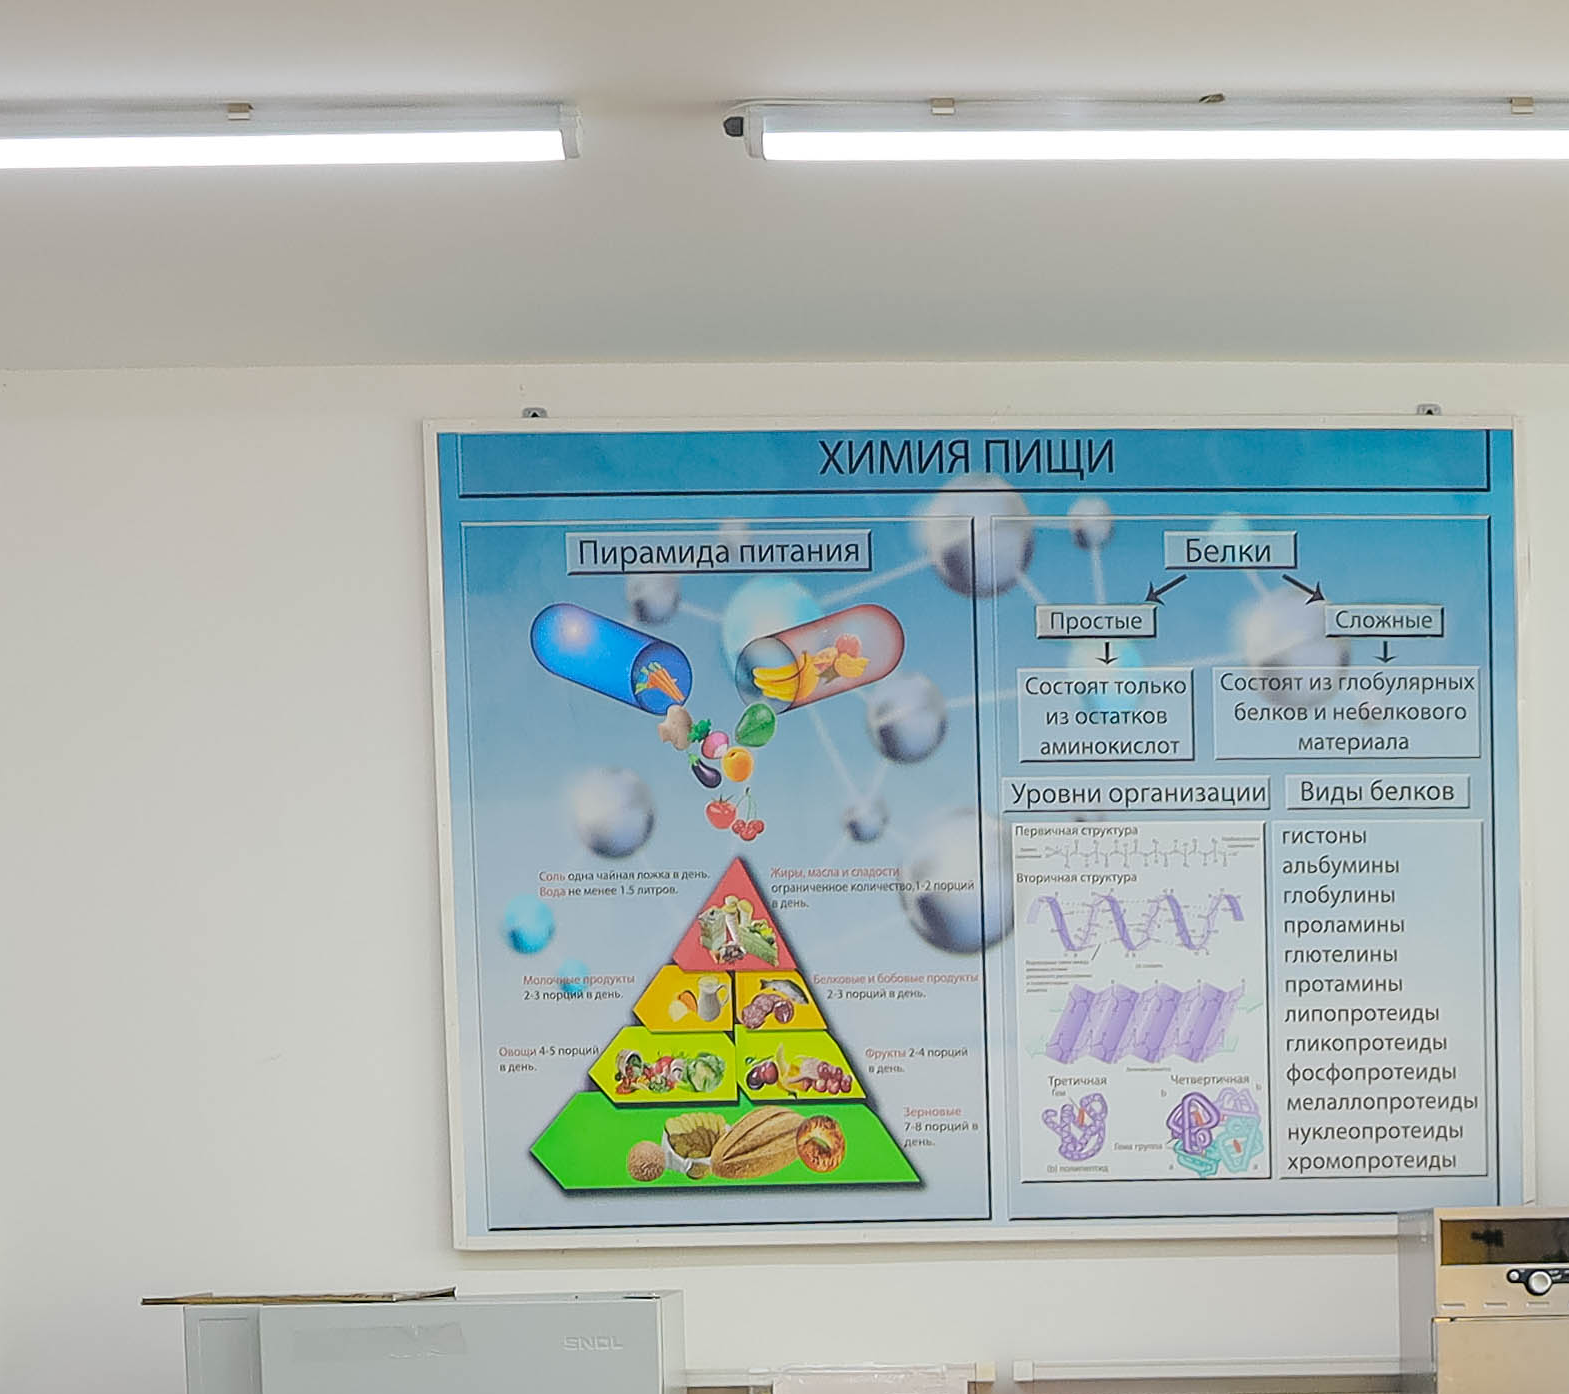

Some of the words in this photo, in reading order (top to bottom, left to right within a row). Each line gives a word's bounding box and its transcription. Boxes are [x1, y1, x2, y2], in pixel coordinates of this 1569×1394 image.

[818, 439, 969, 475] ХИМИЯ
[985, 438, 1115, 479] ПИЩИ
[578, 539, 730, 570] Пирамида
[738, 540, 859, 565] питания
[1186, 538, 1271, 563] Белки
[1050, 612, 1142, 633] Простые
[1335, 609, 1432, 630] Сложные
[1025, 676, 1108, 695] Состоят
[1114, 678, 1186, 695] только
[1220, 672, 1303, 692] Состоят
[1309, 676, 1331, 691] из
[1337, 671, 1474, 697] глобулярных
[1045, 710, 1068, 725] из
[1075, 709, 1167, 725] остатков
[1234, 703, 1308, 721] белков
[1314, 706, 1326, 720] и
[1332, 702, 1466, 720] небелкового
[1040, 738, 1180, 756] аминокислот
[1298, 735, 1409, 754] материала
[1011, 782, 1101, 807] Уровни
[1108, 783, 1266, 807] организации
[1300, 781, 1363, 804] Виды
[1371, 780, 1454, 801] белков
[1015, 825, 1079, 838] Первичная
[1081, 827, 1138, 838] структура
[1282, 829, 1367, 845] гистоны
[770, 867, 806, 879] Жиры,
[808, 868, 839, 877] масла
[842, 868, 849, 877] и
[851, 867, 900, 879] сладости
[1282, 855, 1400, 879] альбумины
[539, 871, 565, 882] Соль
[568, 873, 594, 882] одна
[596, 870, 635, 881] чайная
[637, 871, 670, 880] ложка
[672, 872, 679, 880] в
[681, 870, 710, 882] день.
[1016, 872, 1078, 885] Вторичная
[1080, 873, 1137, 885] структура
[539, 887, 566, 898] Вода
[568, 887, 581, 896] не
[584, 887, 617, 896] менее
[620, 886, 635, 895] 1.5
[637, 886, 679, 897] литров.
[771, 882, 848, 894] ограниченное
[934, 880, 975, 894] порций
[772, 899, 778, 908] в
[780, 898, 809, 909] день.
[1283, 885, 1396, 908] глобулины
[1284, 917, 1405, 938] проламины
[1284, 947, 1398, 964] глютелины
[523, 975, 580, 985] Молочные
[583, 975, 635, 987] продукты
[813, 974, 865, 984] Белковые
[868, 975, 875, 983] и
[878, 973, 924, 983] бобовые
[927, 973, 979, 986] продукты
[1284, 976, 1403, 997] протамины
[524, 991, 540, 1000] 2-3
[543, 990, 584, 1002] порций
[586, 991, 592, 999] в
[595, 990, 624, 1001] день.
[827, 989, 843, 999] 2-3
[845, 988, 886, 1001] порций
[889, 990, 895, 998] в
[897, 989, 927, 1000] день.
[1284, 1006, 1440, 1026] липопротеиды
[499, 1047, 536, 1058] Овощи
[539, 1046, 556, 1055] 4-5
[558, 1045, 599, 1057] порций
[865, 1048, 906, 1059] Фрукты
[909, 1047, 925, 1057] 2-4
[927, 1046, 968, 1058] порций
[1285, 1035, 1447, 1056] гликопротеиды
[500, 1063, 506, 1071] в
[508, 1062, 537, 1073] день.
[868, 1065, 875, 1073] в
[876, 1064, 906, 1075] день.
[1286, 1062, 1457, 1085] фосфопротеиды
[1048, 1076, 1107, 1087] Третичная
[1171, 1075, 1250, 1085] Четвертичная
[904, 1106, 961, 1118] Зерновые
[1287, 1093, 1478, 1115] мелаллопротеиды
[904, 1122, 921, 1132] 7-8
[925, 1121, 969, 1134] порций
[971, 1123, 978, 1131] в
[1287, 1123, 1463, 1144] нуклеопротеиды
[903, 1137, 935, 1149] день.
[1287, 1152, 1457, 1174] хромопротеиды
